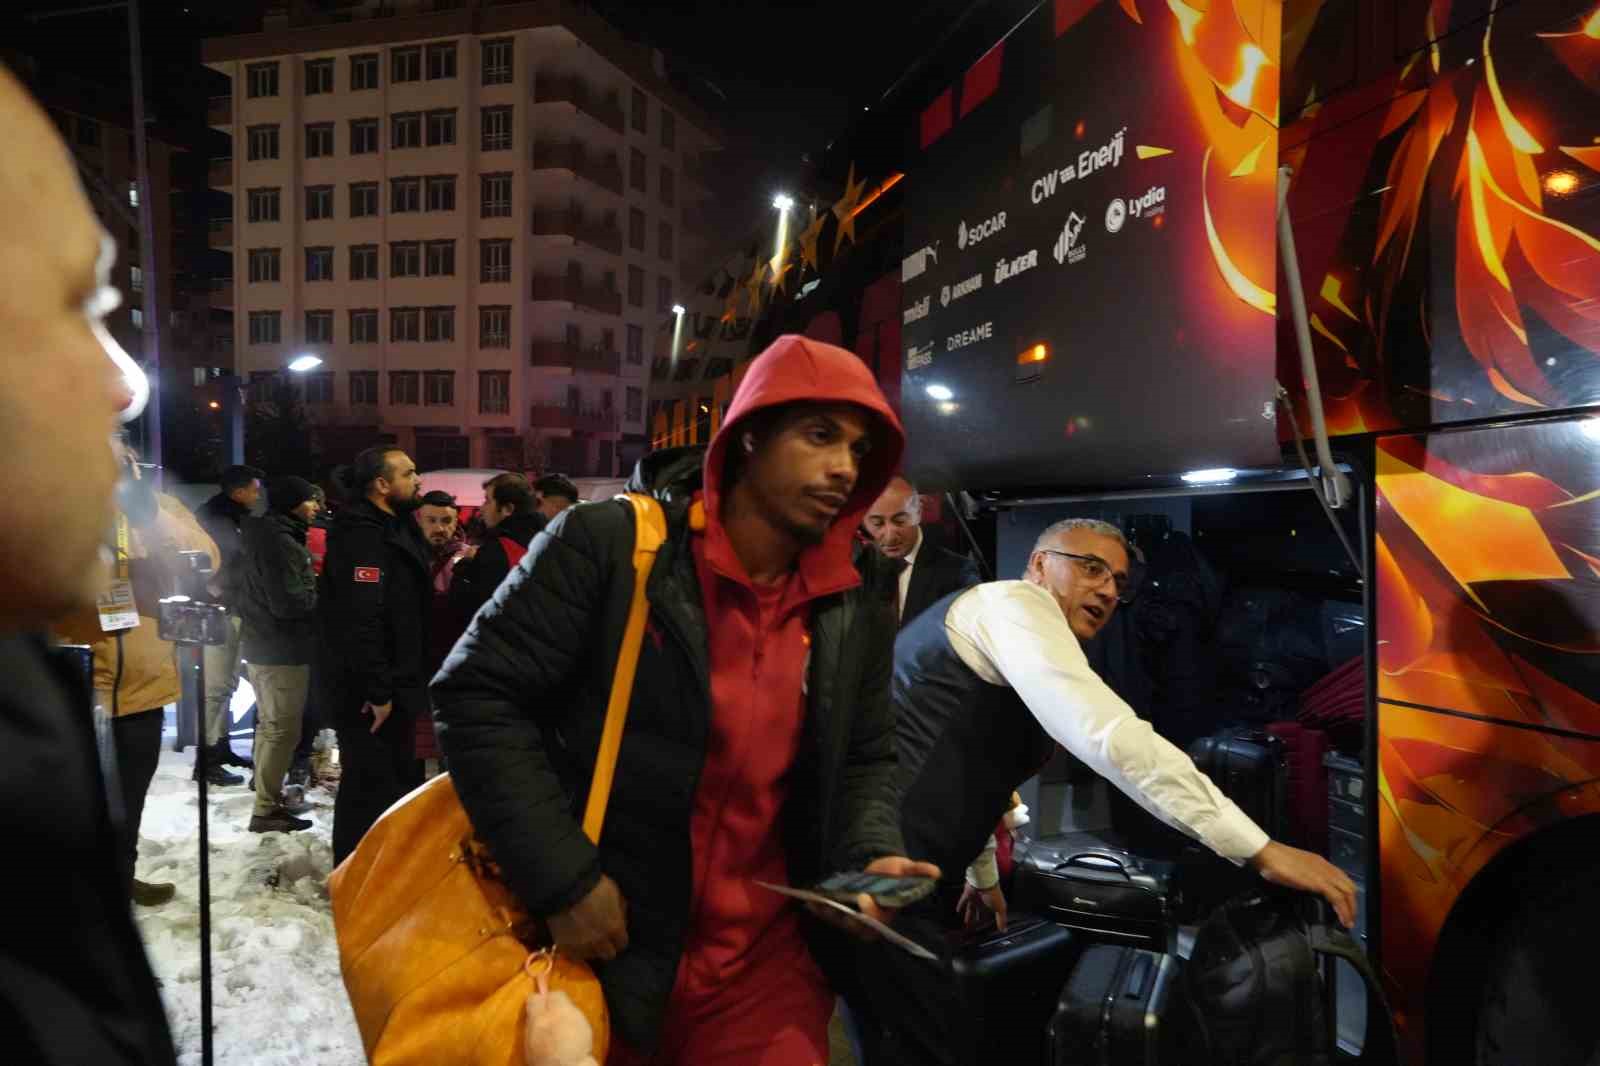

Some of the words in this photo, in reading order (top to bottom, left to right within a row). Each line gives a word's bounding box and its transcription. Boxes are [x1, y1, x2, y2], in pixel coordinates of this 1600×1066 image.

[1031, 169, 1059, 204] CW
[1078, 126, 1128, 180] Enerji
[1129, 186, 1166, 217] Lydia
[968, 211, 1007, 246] SOCAR
[994, 248, 1038, 284] ÜLKER
[946, 321, 993, 352] DREAME
